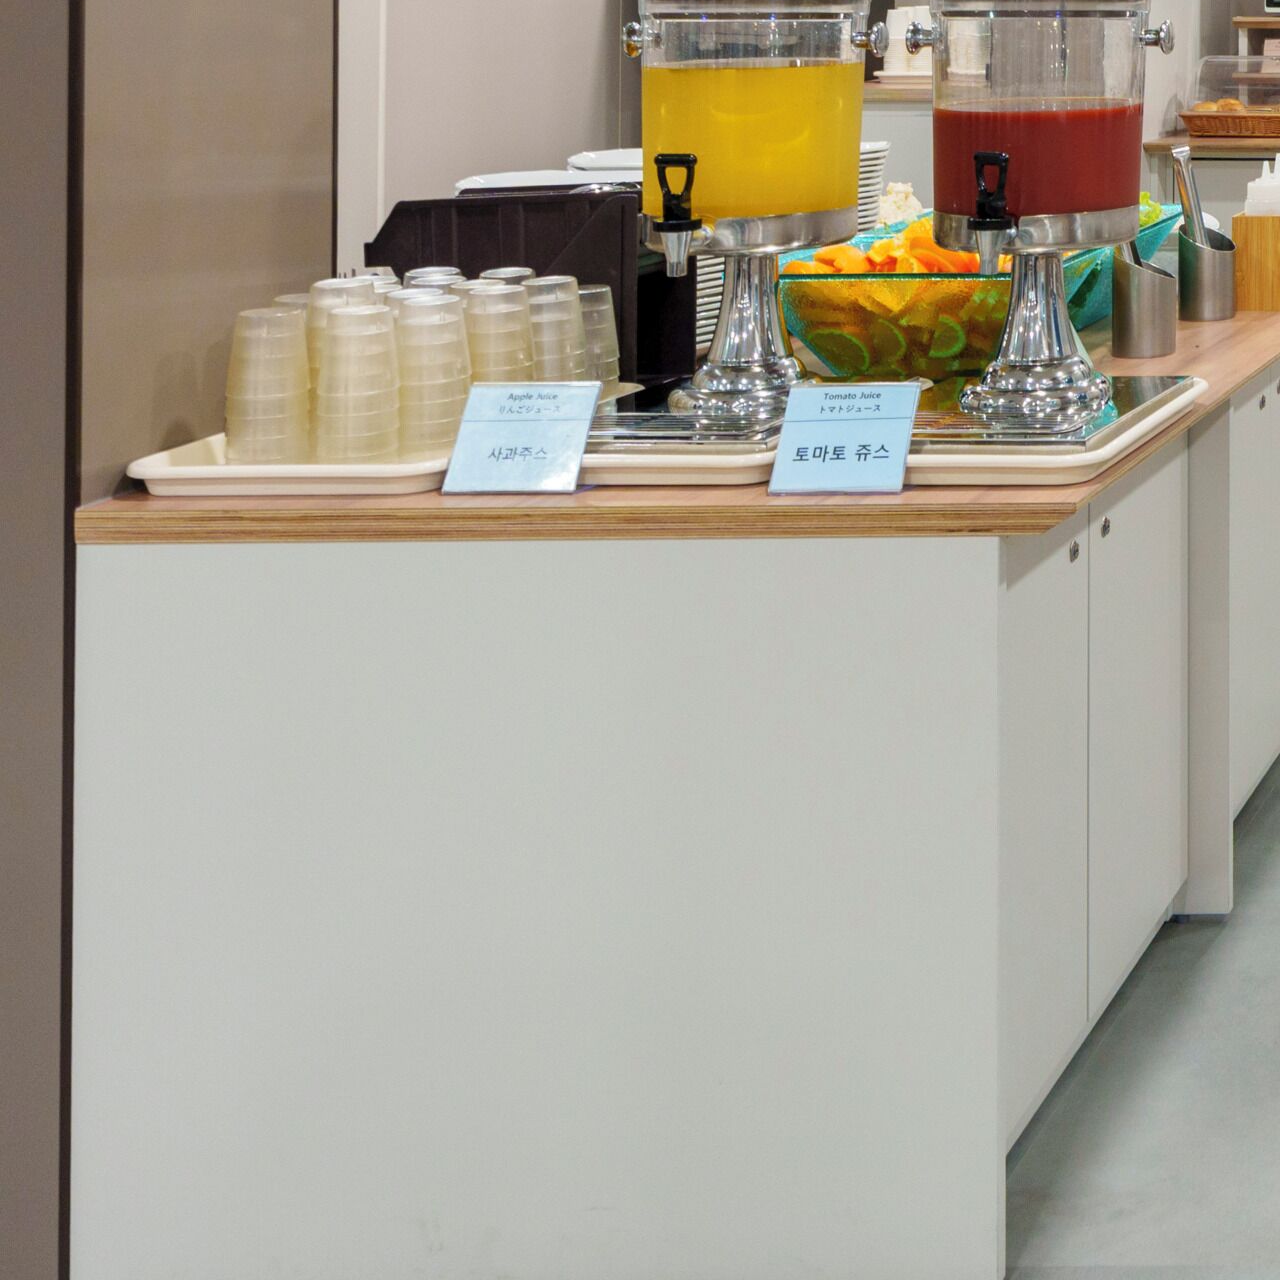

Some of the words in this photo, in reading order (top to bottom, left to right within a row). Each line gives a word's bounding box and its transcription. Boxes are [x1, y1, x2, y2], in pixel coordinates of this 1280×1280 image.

[506, 393, 534, 402] Apple
[859, 391, 882, 400] Juice
[820, 404, 881, 414] トマトジュース
[488, 447, 548, 462] 사과주스
[792, 445, 846, 463] 토마토
[855, 444, 890, 462] 쥬스
